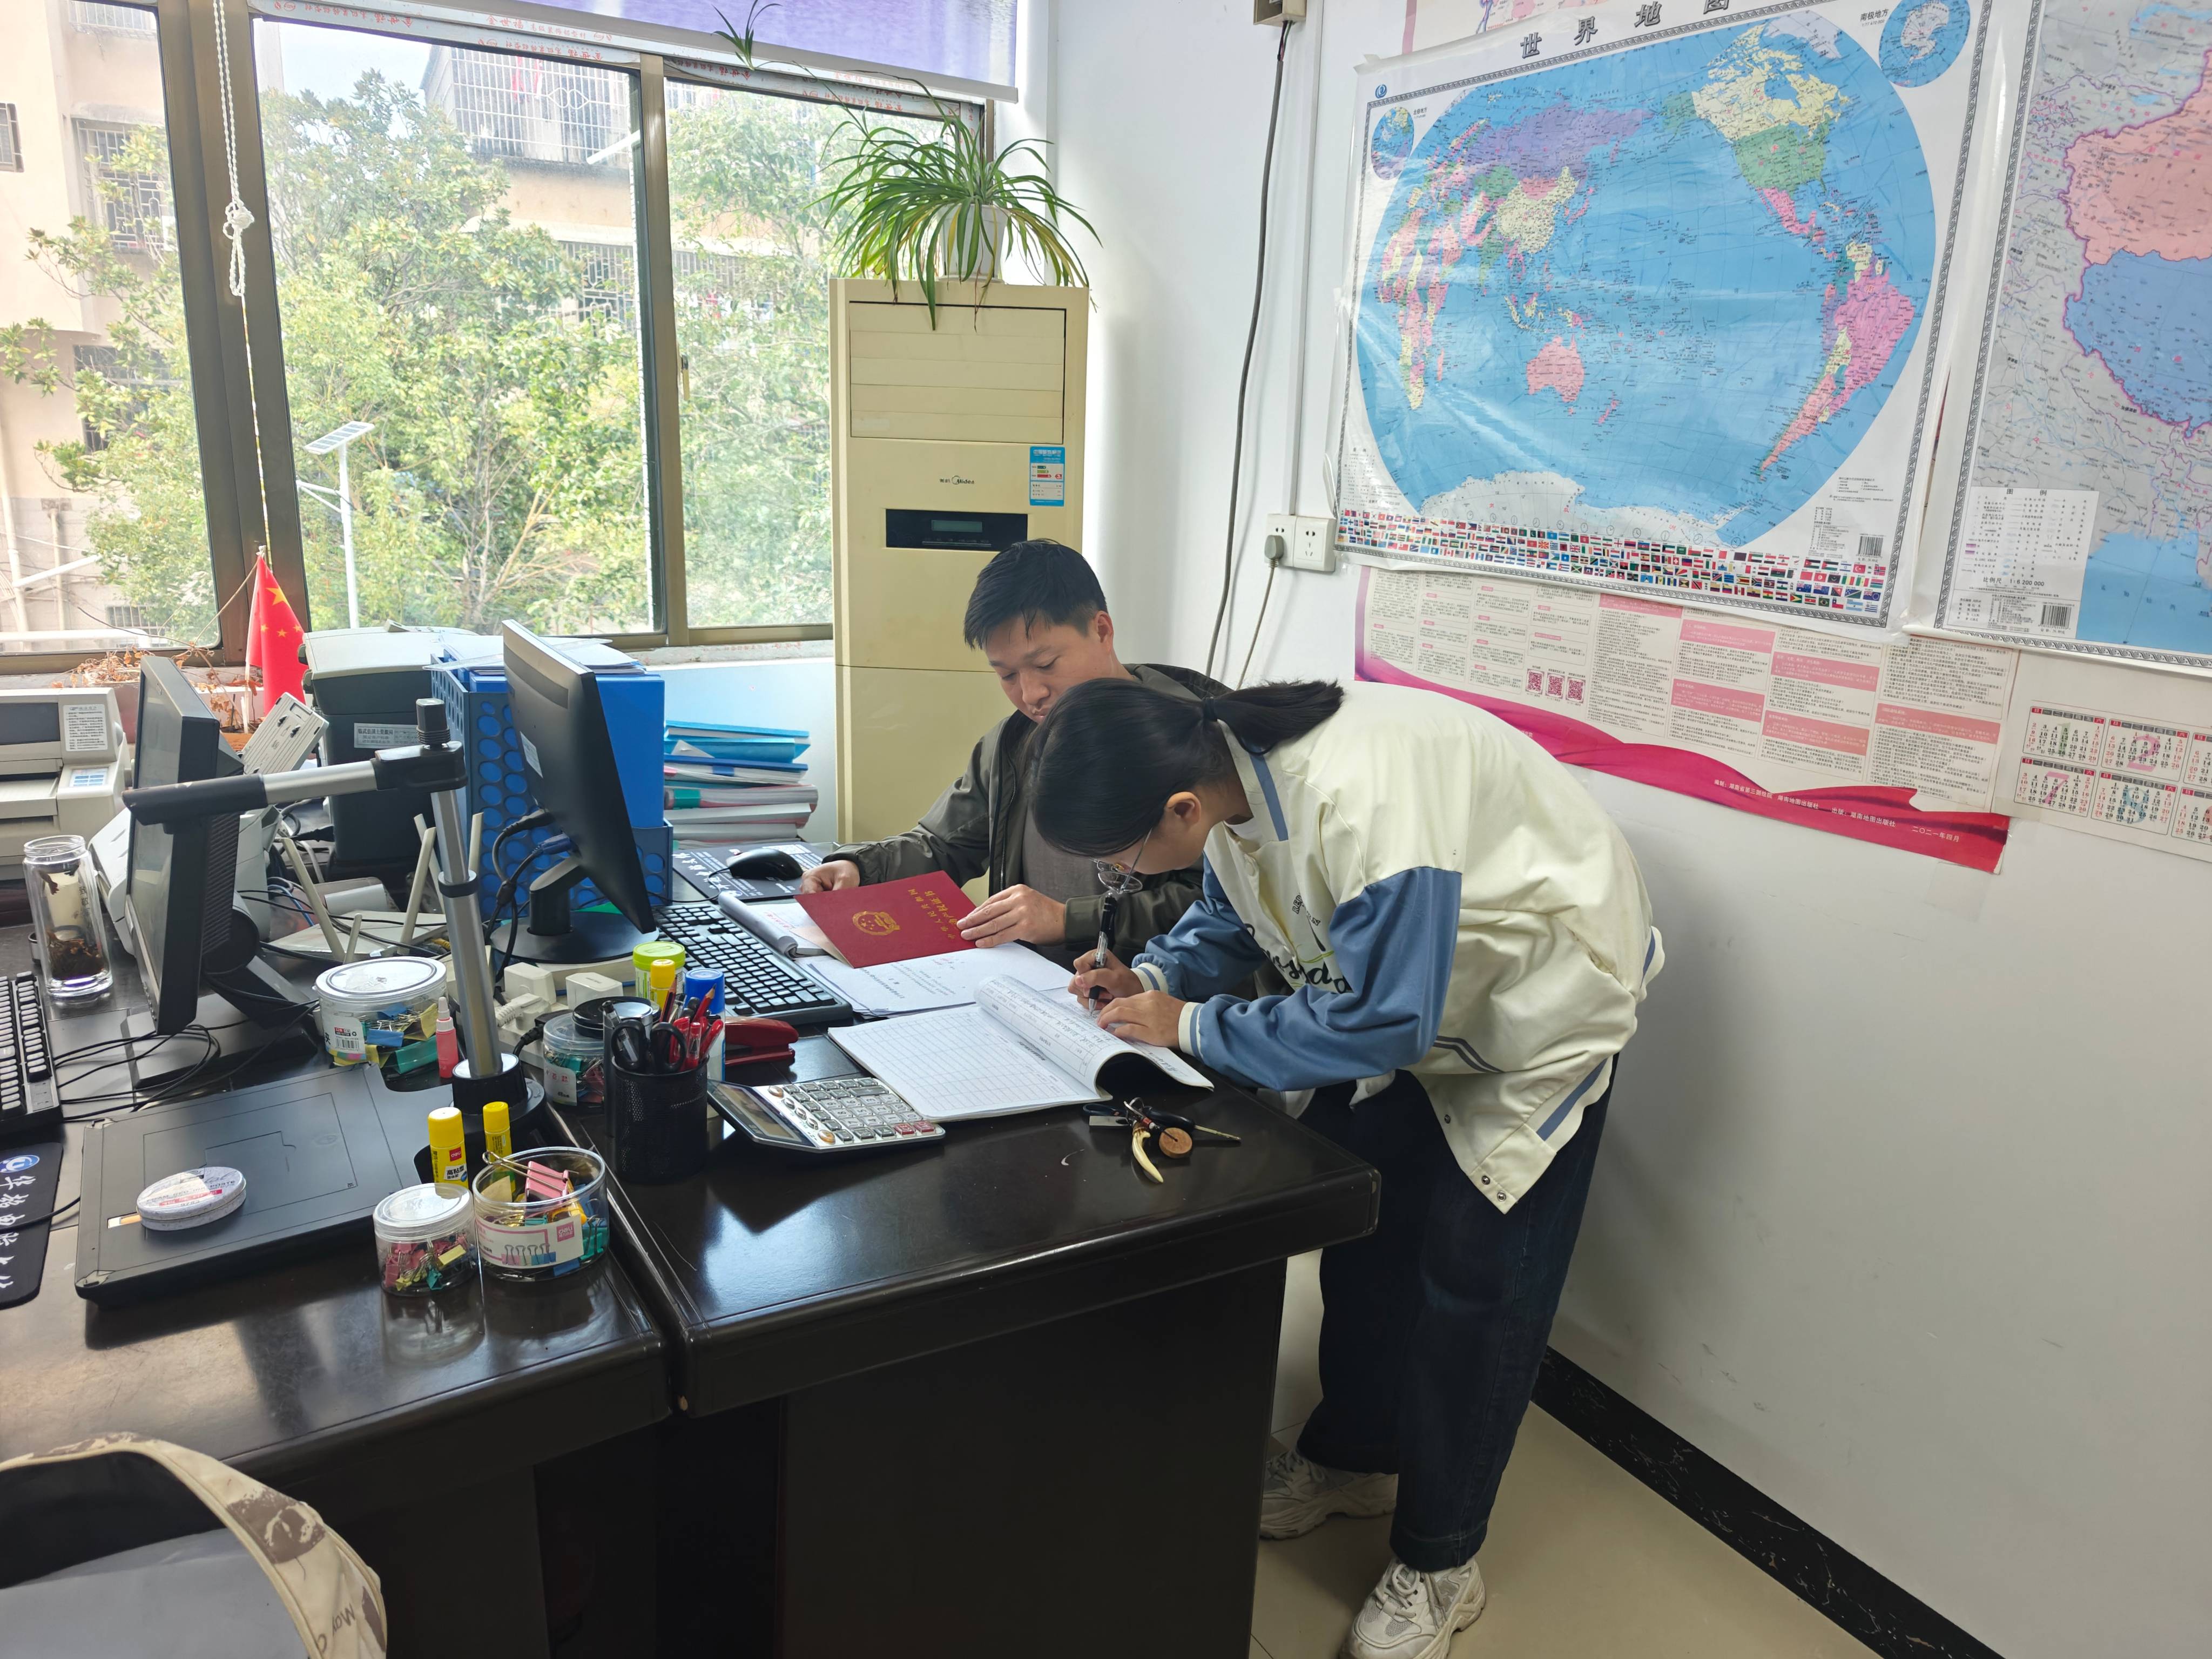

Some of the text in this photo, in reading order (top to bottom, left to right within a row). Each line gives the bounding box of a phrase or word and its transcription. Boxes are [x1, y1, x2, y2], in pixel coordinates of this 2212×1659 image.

[487, 15, 524, 29] 金世福
[1860, 9, 1889, 21] 南极地方
[1777, 795, 1819, 810] 湖南地图出版社
[1850, 811, 1896, 827] 湖南地图出版社
[908, 889, 955, 939] 中华人民共和国
[558, 1226, 572, 1235] deli
